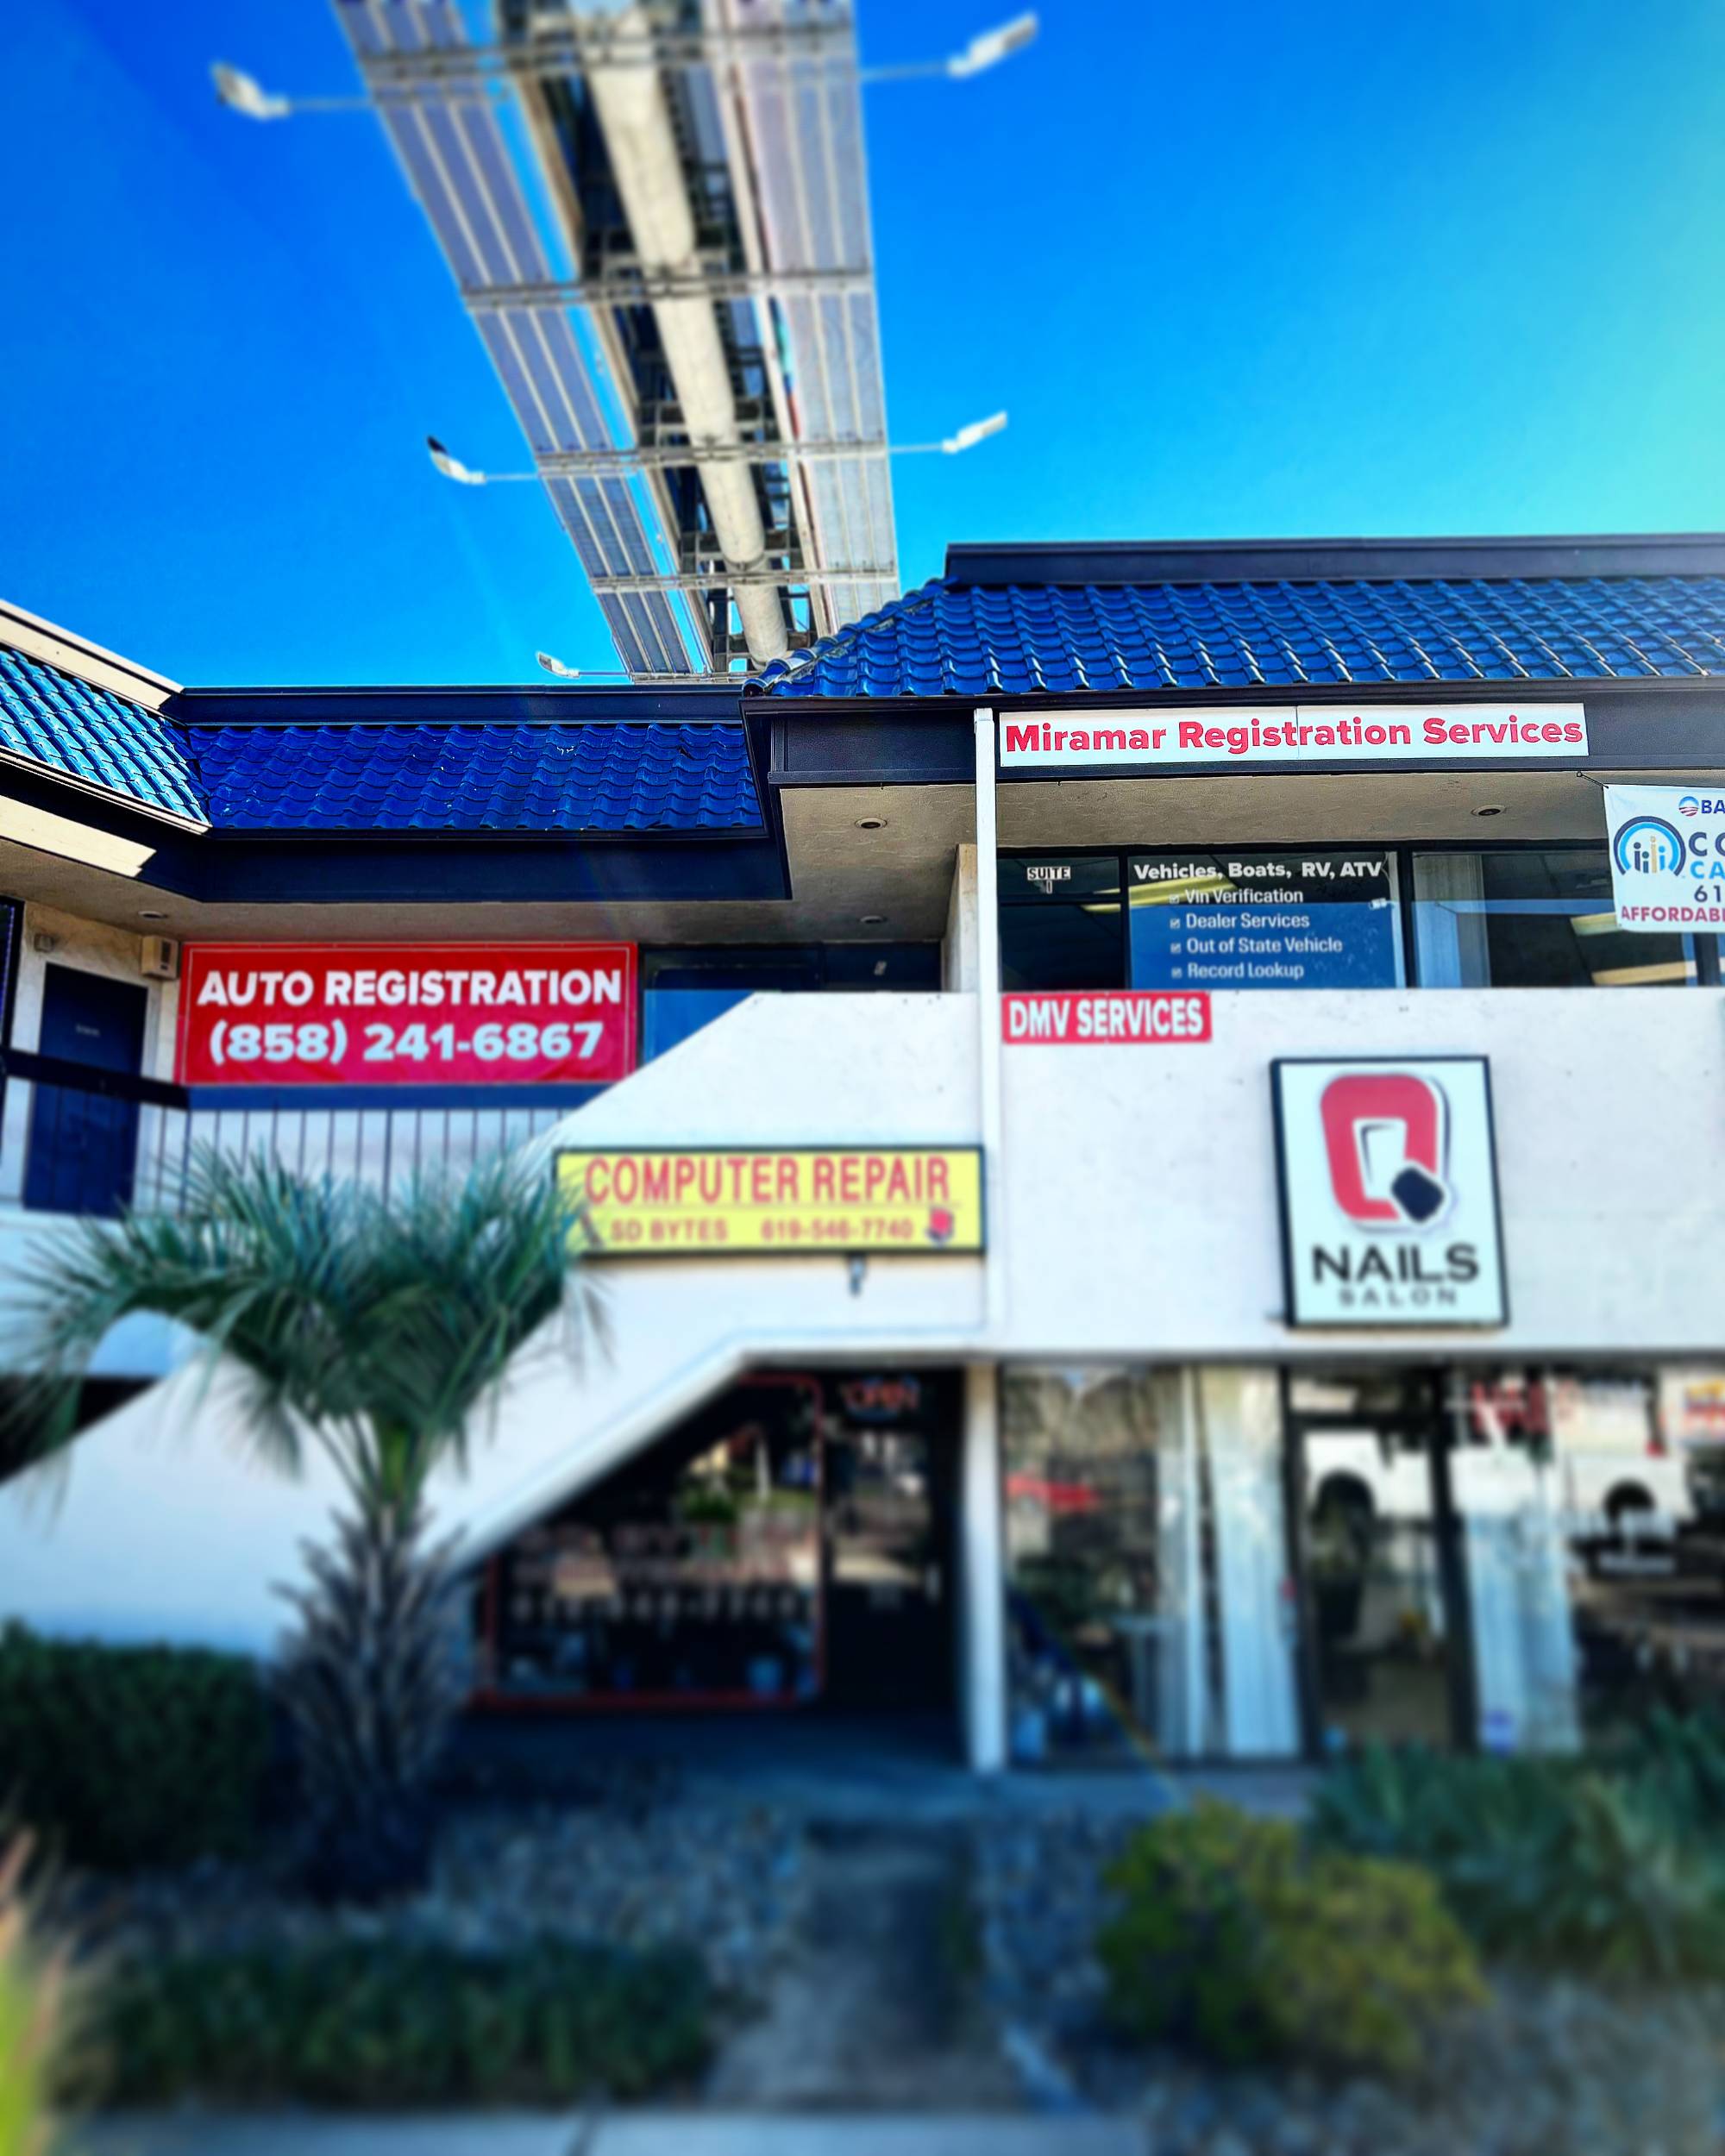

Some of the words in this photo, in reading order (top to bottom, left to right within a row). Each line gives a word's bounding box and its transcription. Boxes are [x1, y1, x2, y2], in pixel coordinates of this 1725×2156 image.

[1006, 722, 1166, 752] Miramar
[1178, 716, 1411, 755] Registration
[1422, 714, 1583, 744] Services
[1028, 867, 1070, 880] SUITE
[1134, 863, 1223, 880] Vehicles,
[1228, 862, 1292, 878] Boats,
[1302, 862, 1335, 879] RV,
[1339, 862, 1383, 877] ATV
[1185, 889, 1209, 904] Vin
[1213, 888, 1303, 904] Verification
[1186, 913, 1237, 929] Dealer
[1240, 912, 1310, 929] Services
[1622, 906, 1725, 924] AFFORDAB
[1187, 938, 1216, 953] Out
[1220, 937, 1234, 953] of
[1238, 937, 1282, 953] State
[1283, 937, 1343, 953] Vehicle
[1188, 962, 1245, 978] Record
[1248, 962, 1305, 981] Lookup
[196, 971, 314, 1006] AUTO
[324, 969, 622, 1006] REGISTRATION
[1008, 999, 1070, 1037] DMV
[1076, 998, 1203, 1037] SERVICES
[210, 1018, 348, 1065] (858)
[362, 1021, 604, 1062] 241-6867
[584, 1156, 799, 1205] COMPUTER
[813, 1156, 950, 1202] REPAIR
[650, 1219, 727, 1242] BYTES
[1311, 1244, 1480, 1283] NAILS
[1337, 1288, 1458, 1307] SALON
